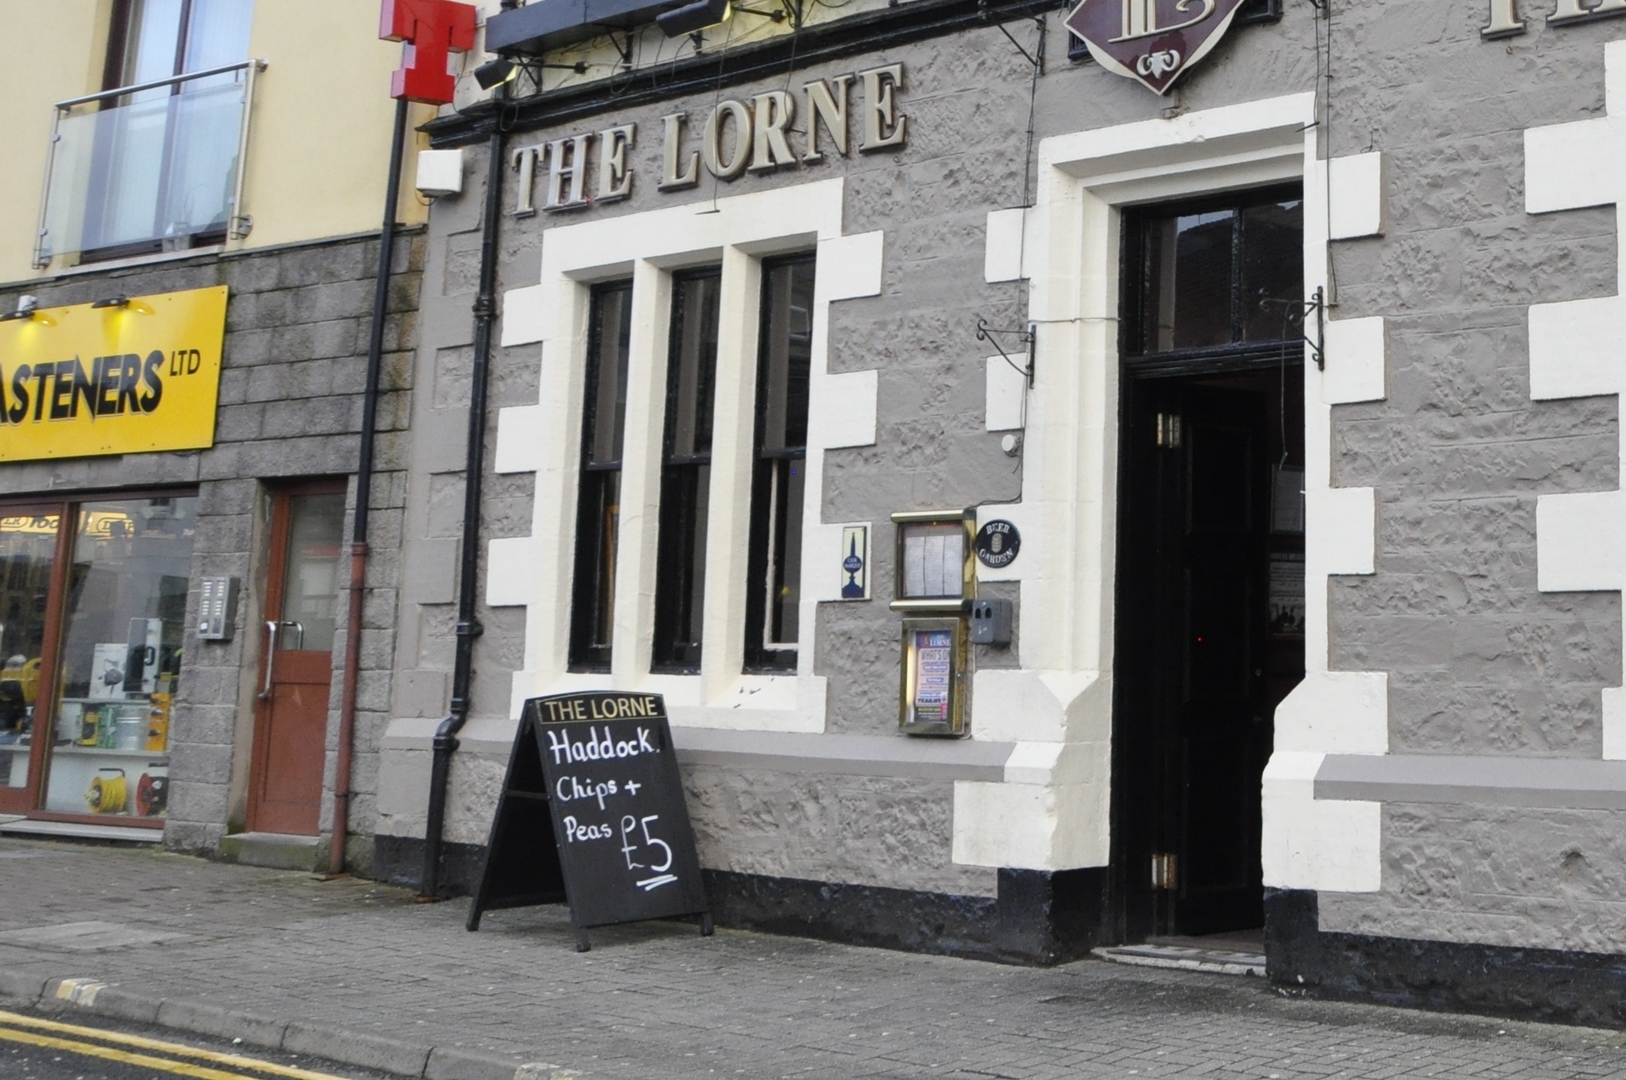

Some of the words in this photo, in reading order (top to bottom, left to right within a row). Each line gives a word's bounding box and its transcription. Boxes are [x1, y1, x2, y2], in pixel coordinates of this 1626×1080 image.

[511, 121, 637, 219] THE
[658, 62, 909, 193] LORNE
[169, 349, 201, 377] LTD
[986, 522, 1010, 535] BEER
[979, 548, 1014, 564] GARDEN
[545, 699, 588, 721] THE
[591, 697, 659, 719] LORNE
[556, 776, 618, 811] Chips
[563, 815, 613, 843] Peas
[621, 814, 673, 872] £5
